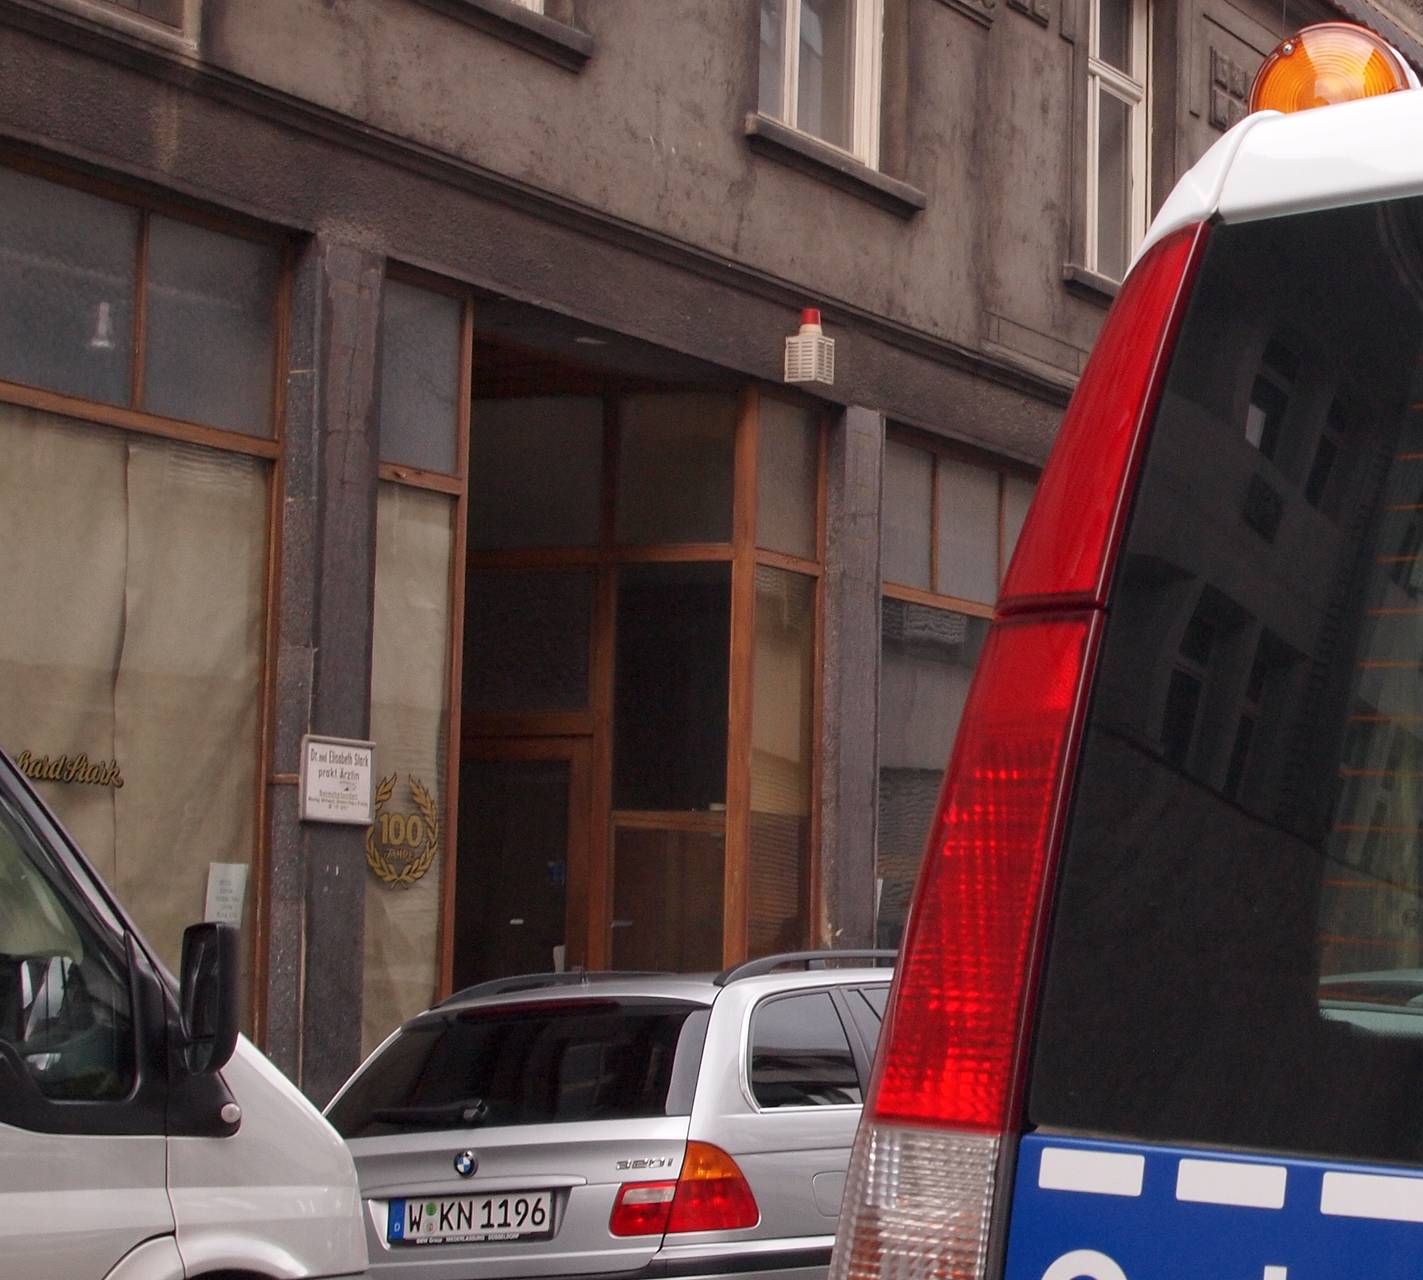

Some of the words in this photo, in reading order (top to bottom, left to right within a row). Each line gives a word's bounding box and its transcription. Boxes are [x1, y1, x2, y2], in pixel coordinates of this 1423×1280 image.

[380, 814, 424, 848] 100
[408, 1203, 424, 1233] W
[439, 1201, 474, 1231] KN
[480, 1197, 547, 1230] 1196
